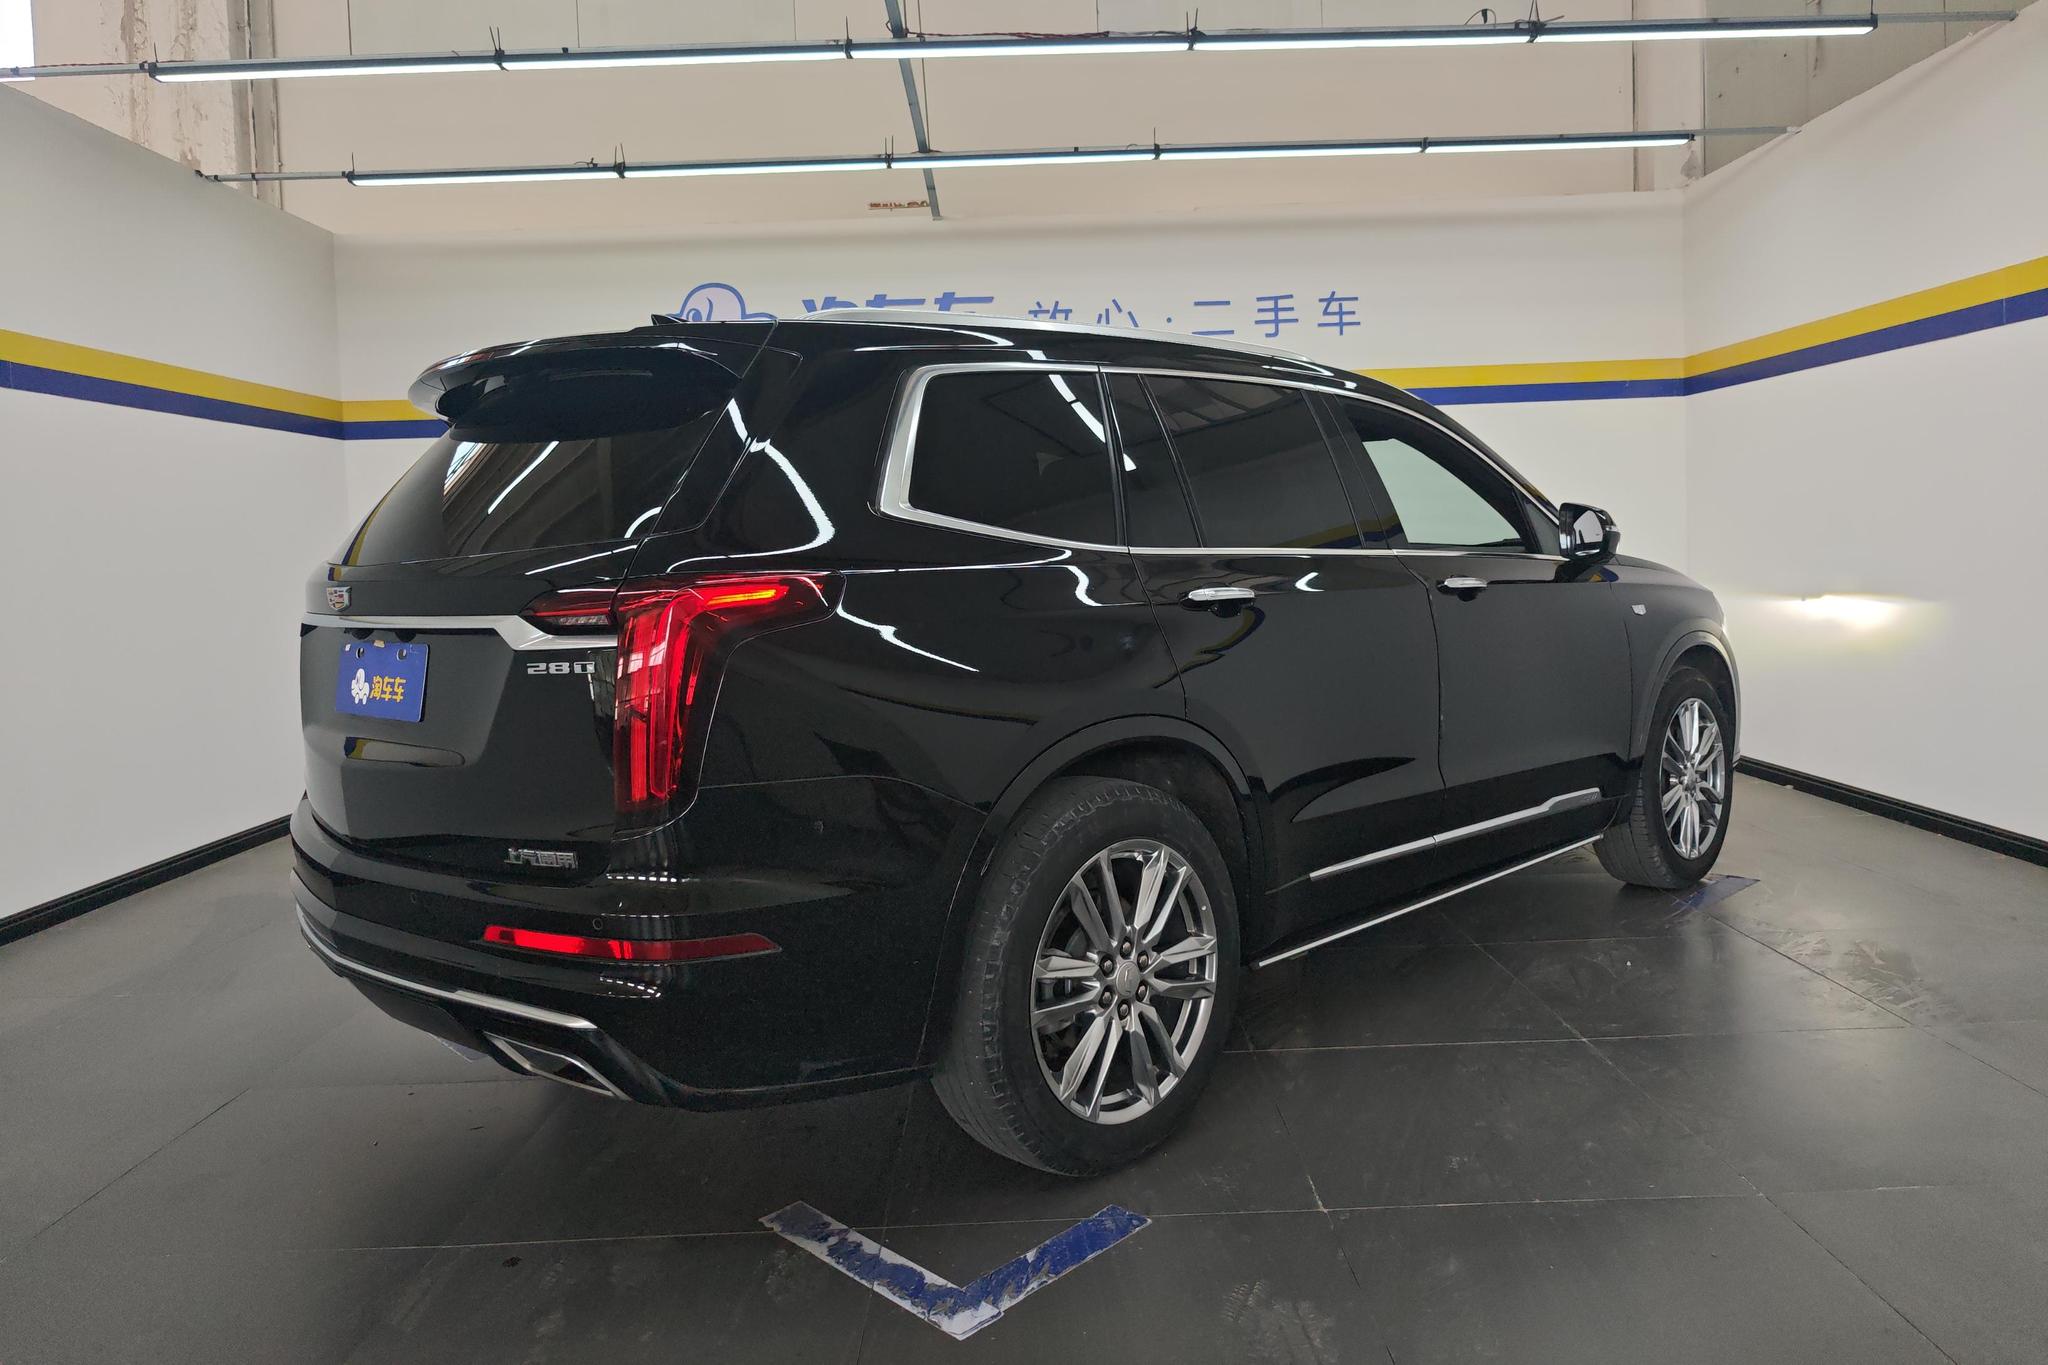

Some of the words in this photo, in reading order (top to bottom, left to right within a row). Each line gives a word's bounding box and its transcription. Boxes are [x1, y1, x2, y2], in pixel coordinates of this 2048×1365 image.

[526, 661, 596, 675] 28T
[369, 675, 407, 703] 淘车车
